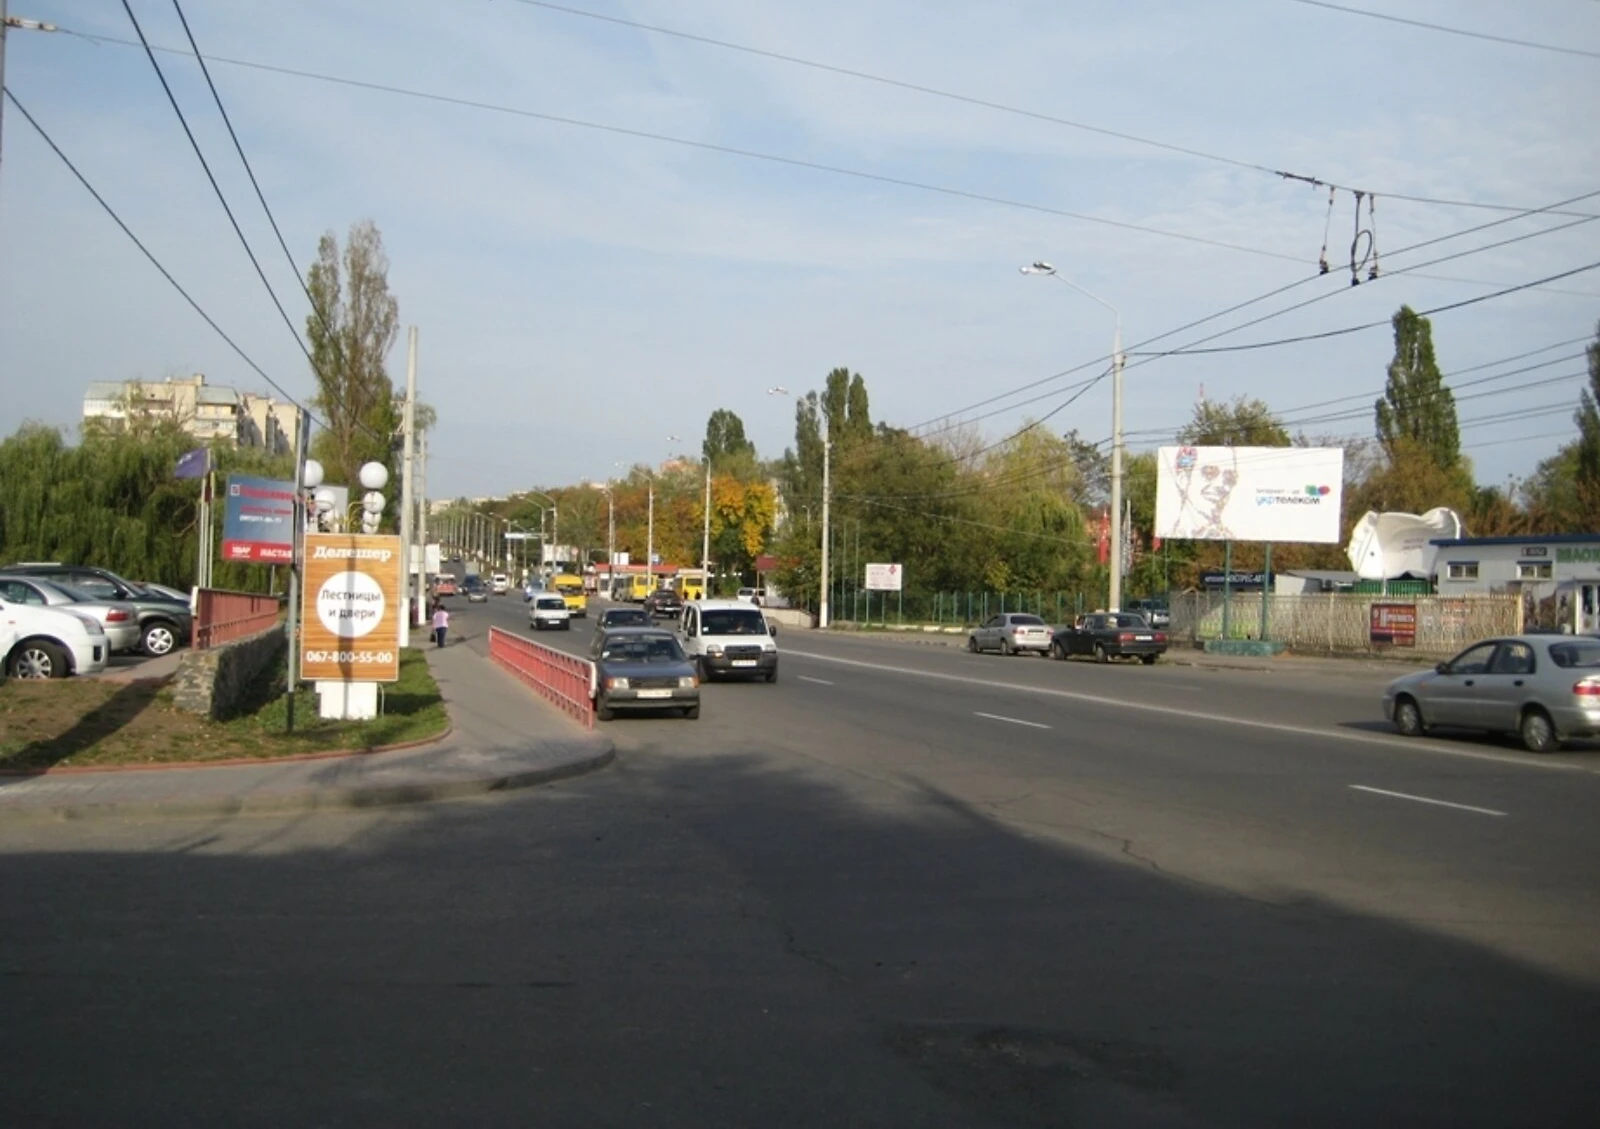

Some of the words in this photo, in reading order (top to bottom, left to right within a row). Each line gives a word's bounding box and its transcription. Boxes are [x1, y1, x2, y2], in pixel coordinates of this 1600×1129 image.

[321, 589, 381, 602] Лестницы
[328, 609, 336, 618] и
[339, 608, 376, 621] двери
[306, 651, 393, 663] 067-800-55-00
